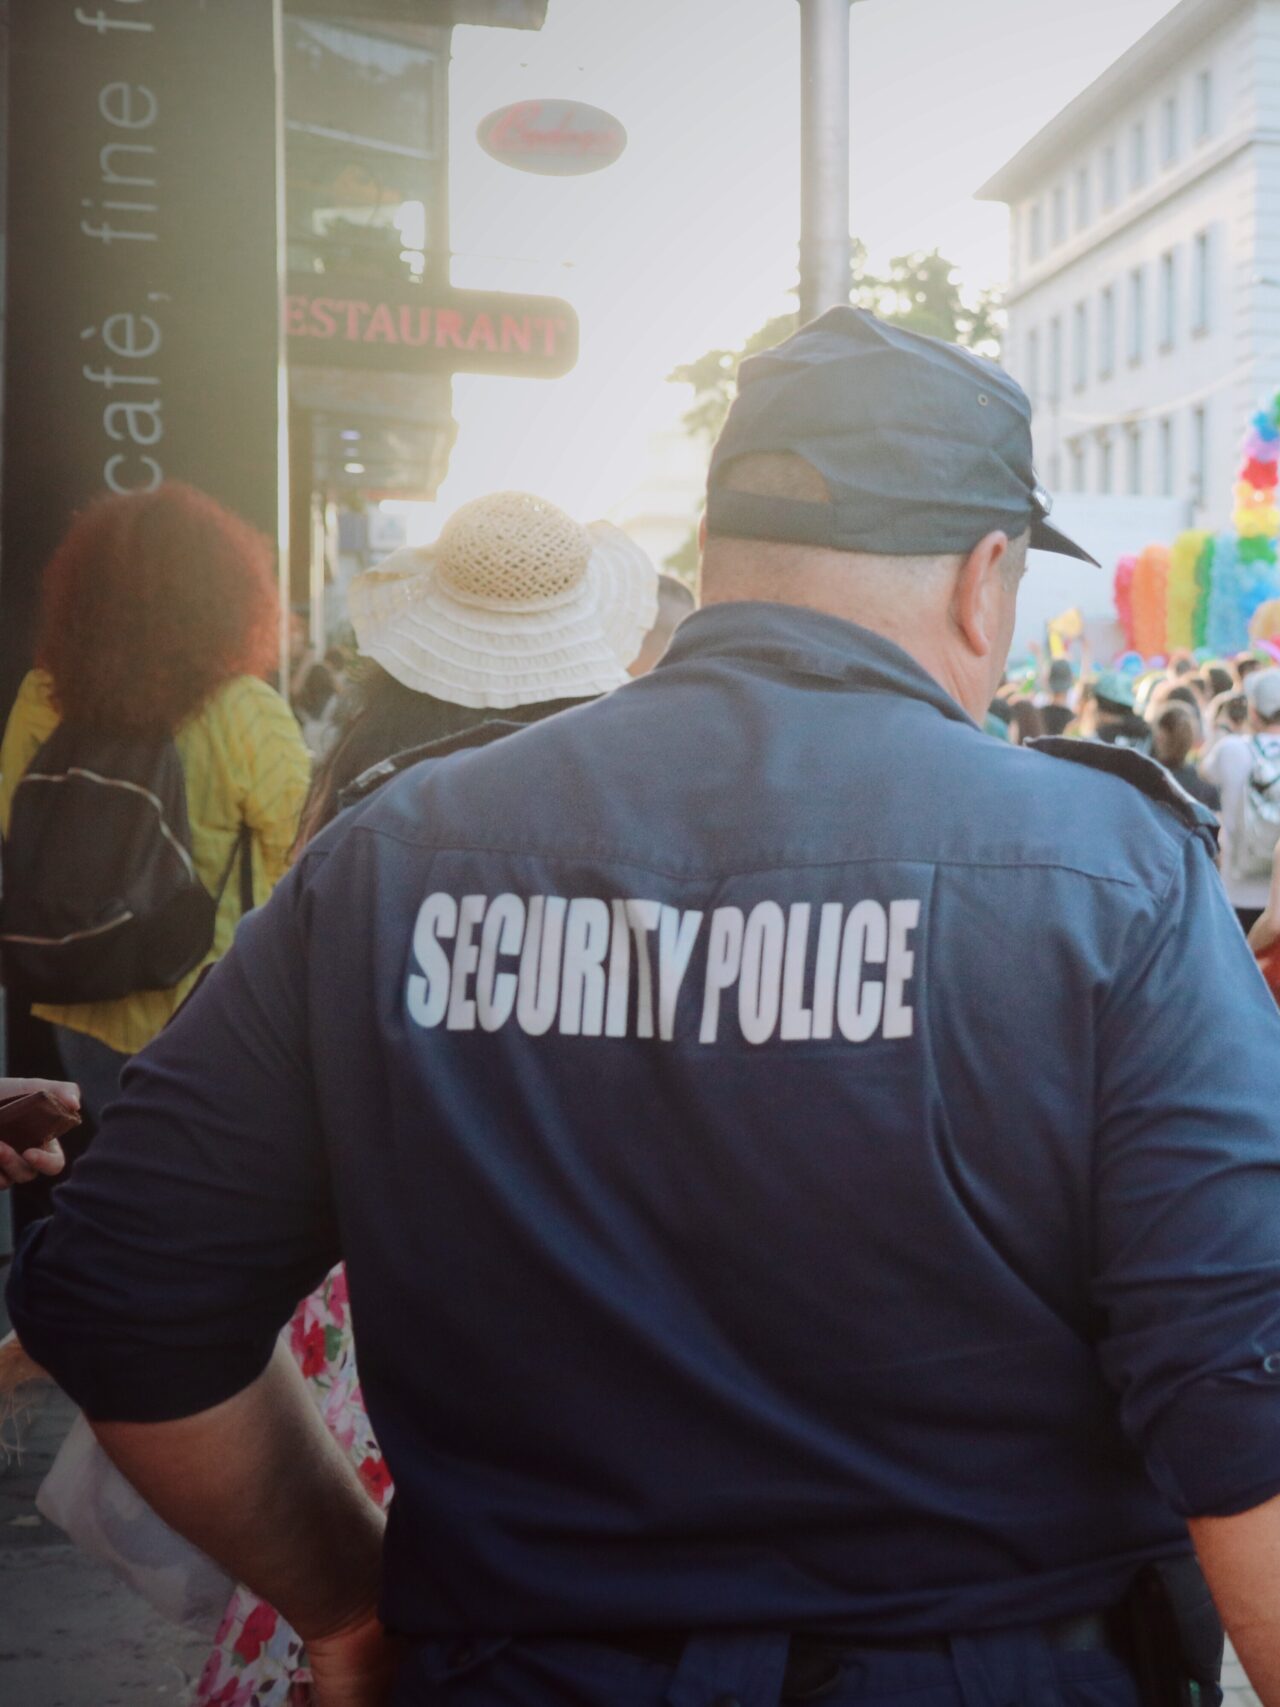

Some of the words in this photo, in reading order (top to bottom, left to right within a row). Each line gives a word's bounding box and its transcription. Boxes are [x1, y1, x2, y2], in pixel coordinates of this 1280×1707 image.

[74, 0, 156, 34] f
[79, 81, 159, 245] fine
[284, 294, 568, 357] ESTAURANT
[406, 892, 703, 1042] SECURITY
[699, 899, 921, 1045] POLICE
